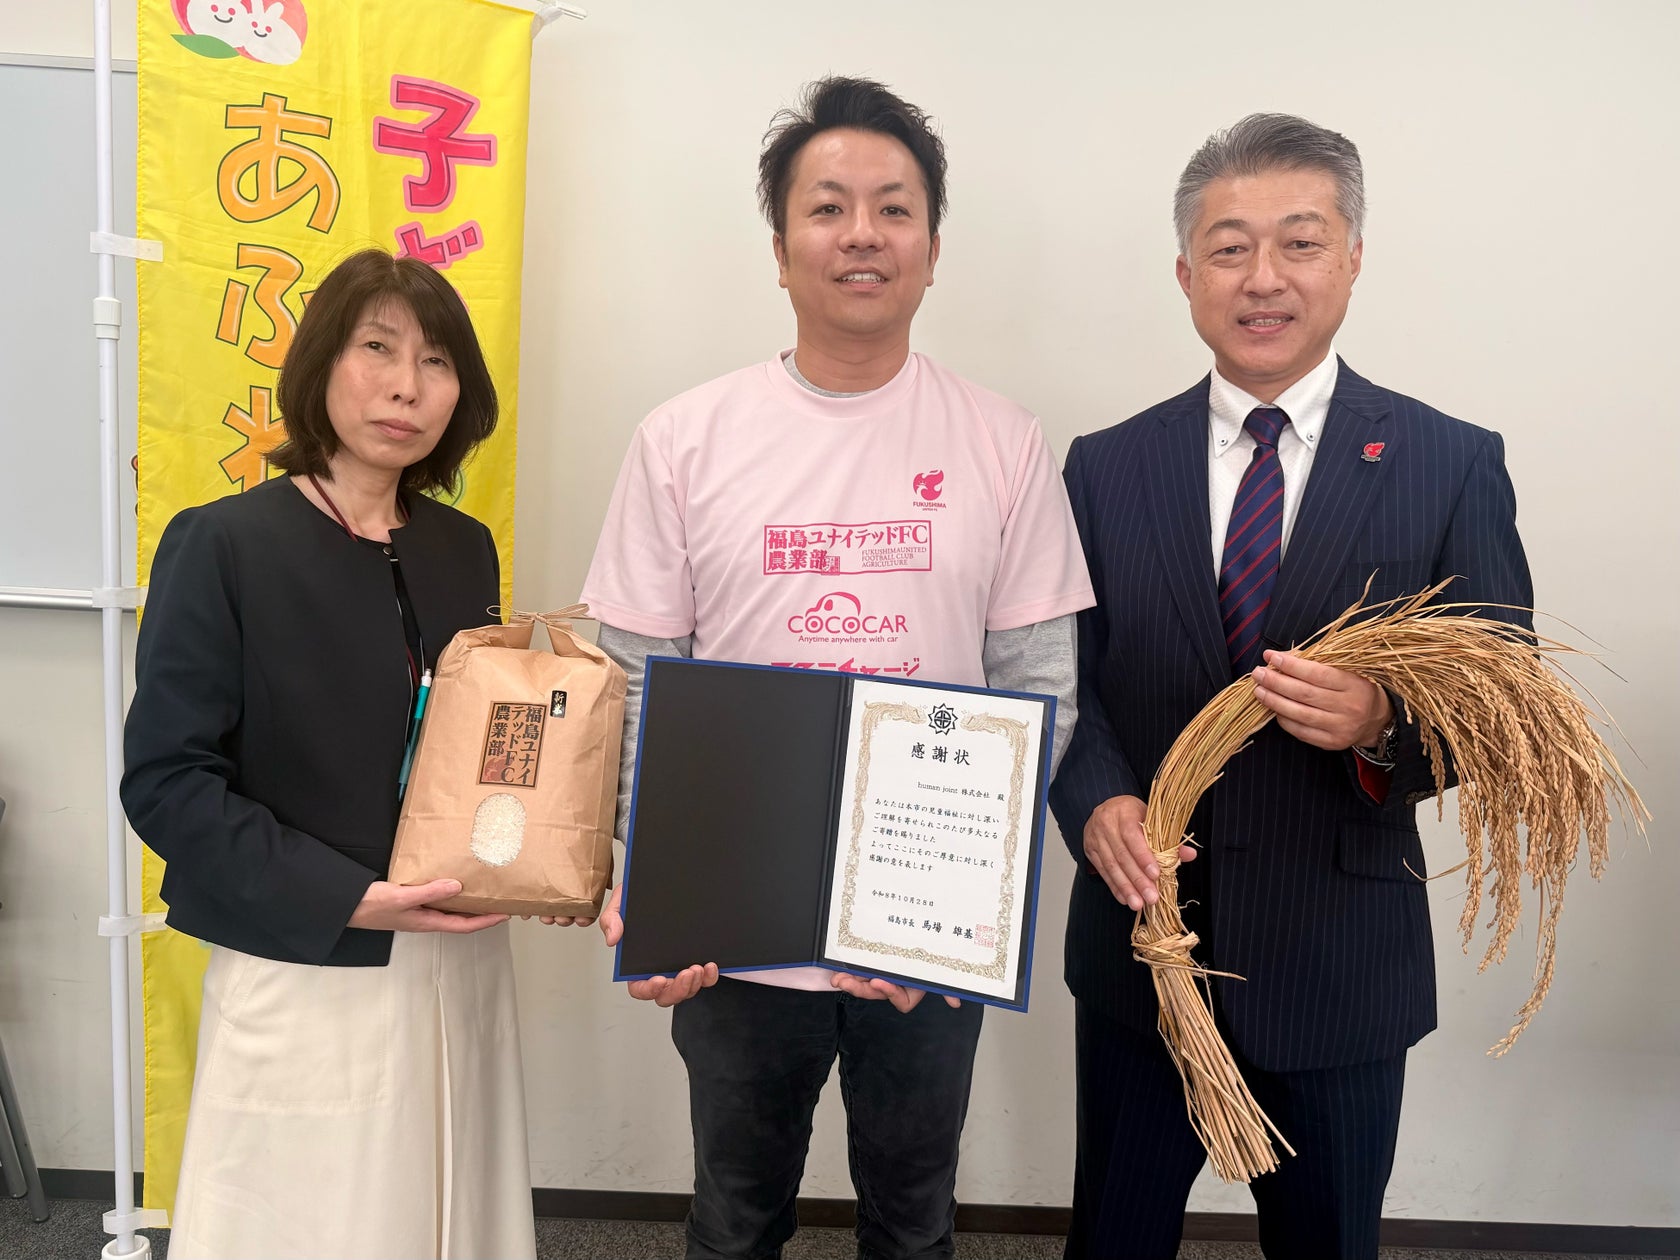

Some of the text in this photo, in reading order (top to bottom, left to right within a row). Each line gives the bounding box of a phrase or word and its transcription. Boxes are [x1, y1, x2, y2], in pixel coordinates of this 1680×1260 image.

[767, 525, 928, 549] 福島ユナイテッドFC
[767, 549, 828, 571] 農業部
[862, 554, 895, 562] FOOTBALL
[862, 559, 908, 568] AGRICULTURE
[787, 615, 909, 634] COCOCAR
[798, 635, 829, 643] Anytime
[831, 636, 867, 644] anywhere
[869, 635, 885, 643] with
[488, 705, 511, 757] 農業部
[911, 742, 971, 766] 感謝状
[917, 781, 940, 791] human
[942, 785, 958, 793] joint
[961, 788, 990, 799] 株式会社
[887, 914, 915, 928] 福島市長
